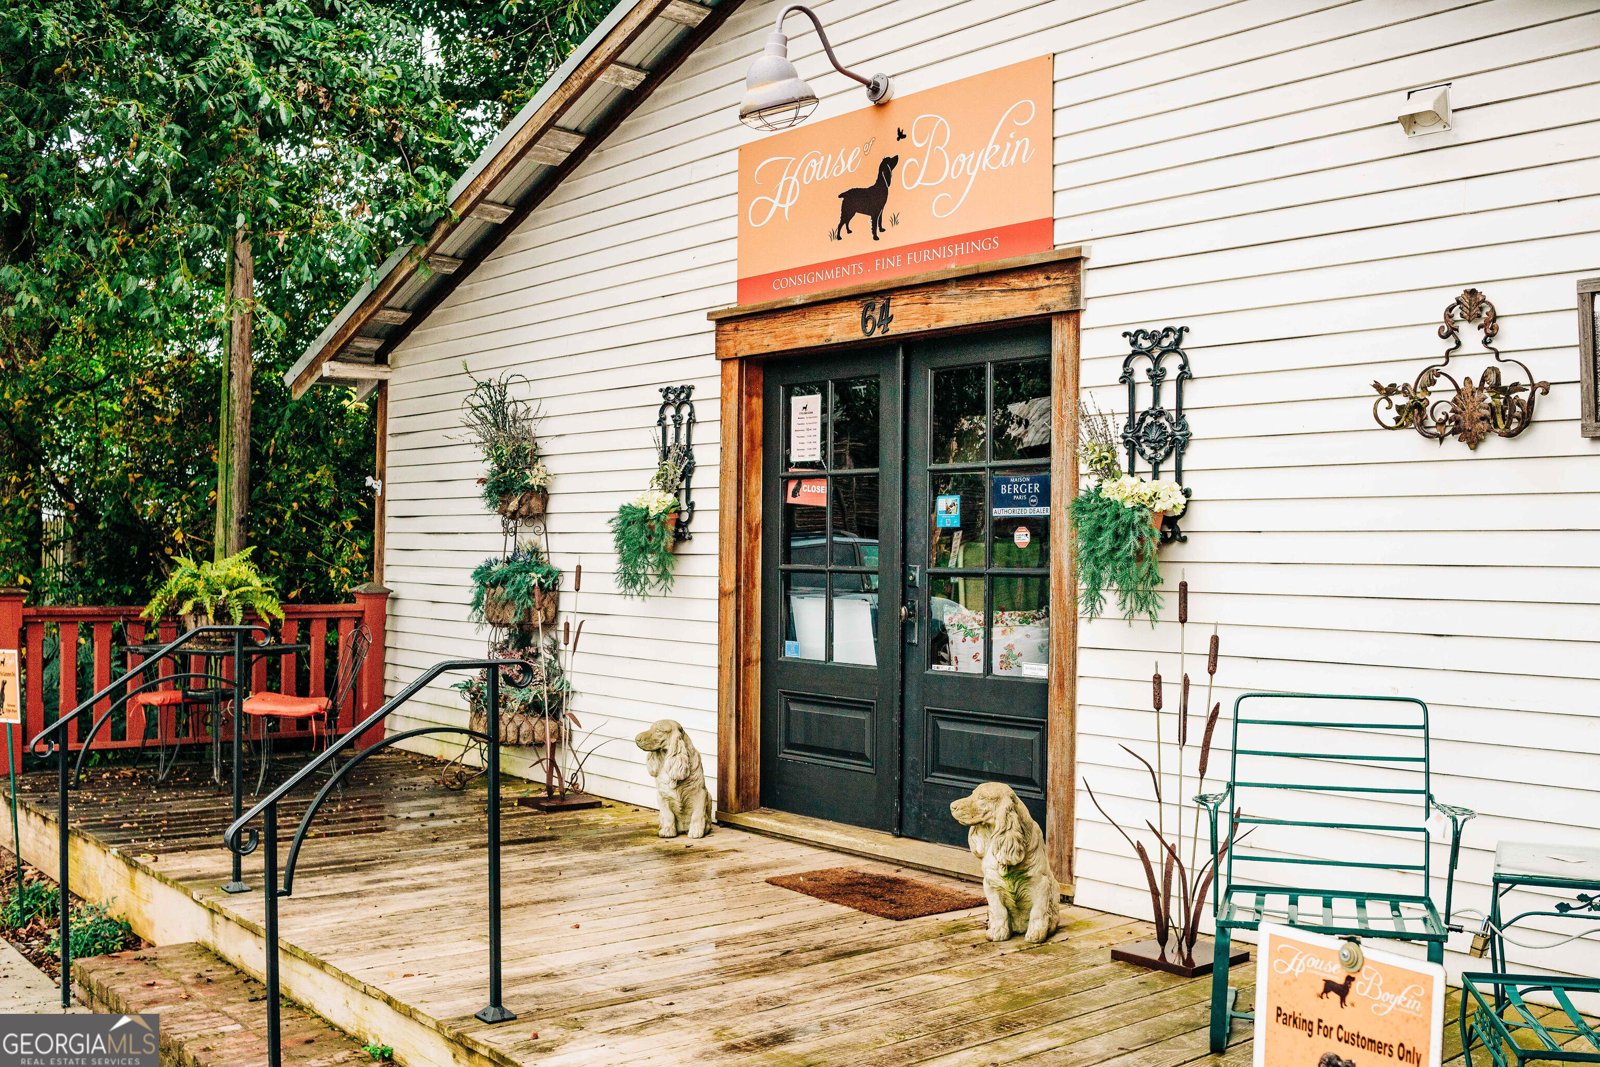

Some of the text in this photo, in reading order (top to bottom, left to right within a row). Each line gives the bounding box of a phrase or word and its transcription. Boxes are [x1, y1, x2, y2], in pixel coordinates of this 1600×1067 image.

[749, 99, 1036, 227] House of Boykin
[772, 262, 864, 291] CONSIGNMENTS
[875, 255, 903, 271] FINE
[907, 236, 1000, 266] FURNISHINGS
[861, 296, 893, 337] 64
[802, 484, 827, 494] CLOSE
[1001, 483, 1040, 494] BERGER
[1273, 944, 1425, 1016] House Boykin
[1275, 1006, 1422, 1067] Parking For Customers Only
